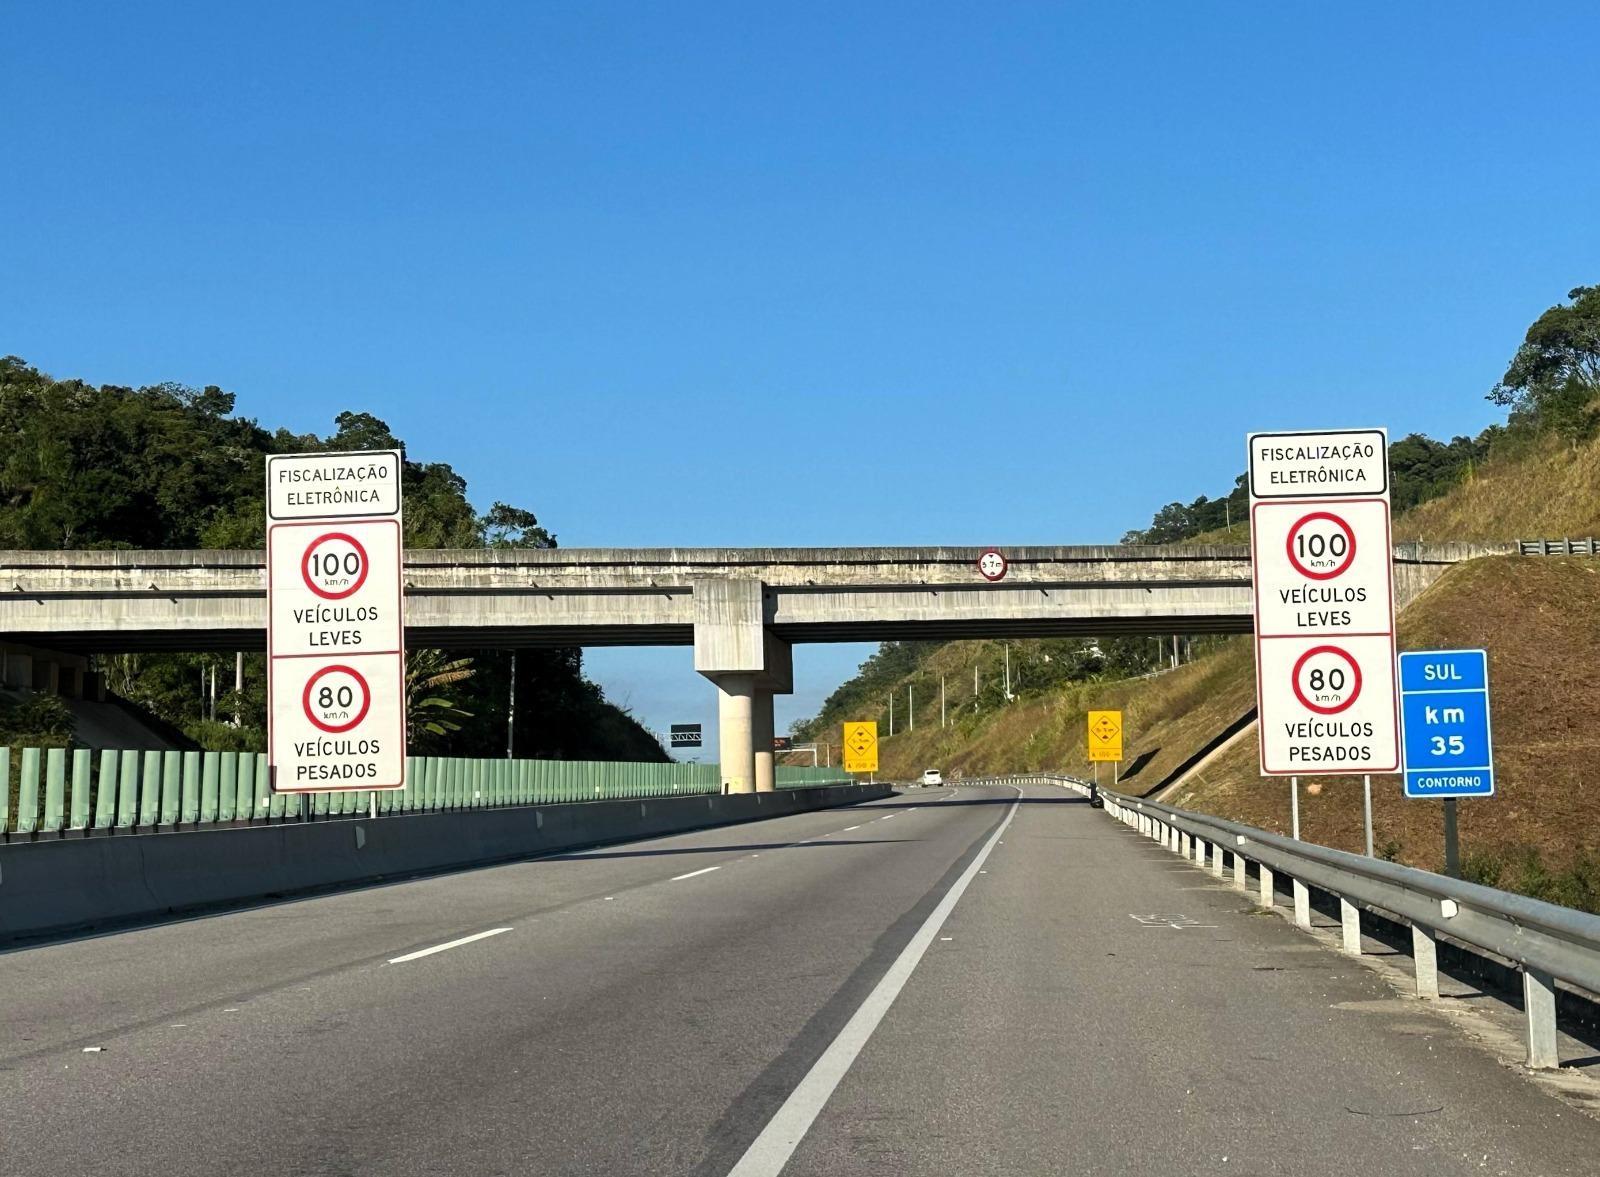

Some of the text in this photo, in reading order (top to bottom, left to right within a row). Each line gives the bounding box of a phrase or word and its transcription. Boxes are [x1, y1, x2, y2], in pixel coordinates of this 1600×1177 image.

[1262, 442, 1374, 462] FISCALIZAÇÃO
[279, 463, 388, 483] FISCALIZAÇÃO
[1270, 466, 1367, 485] ELETRÔNICA
[287, 486, 380, 505] ELETRÔNICA
[1297, 533, 1347, 558] 100
[312, 552, 360, 577] 100
[1310, 559, 1336, 567] km/h
[324, 578, 349, 586] km/h
[1279, 584, 1367, 604] VEÍCULOS
[293, 604, 378, 624] VEÍCULOS
[1297, 611, 1352, 627] LEVES
[309, 630, 362, 646] LEVES
[1309, 668, 1345, 691] 80
[1424, 663, 1462, 680] SUL
[318, 685, 353, 709] 80
[1315, 693, 1341, 702] km/h
[323, 711, 349, 719] km/h
[1425, 705, 1465, 725] km
[1285, 717, 1373, 738] VEÍCULOS
[294, 736, 380, 757] VEÍCULOS
[1289, 745, 1371, 762] PESADOS
[1430, 735, 1465, 756] 35
[297, 763, 377, 781] PESADOS
[1417, 776, 1481, 788] CONTORNO
